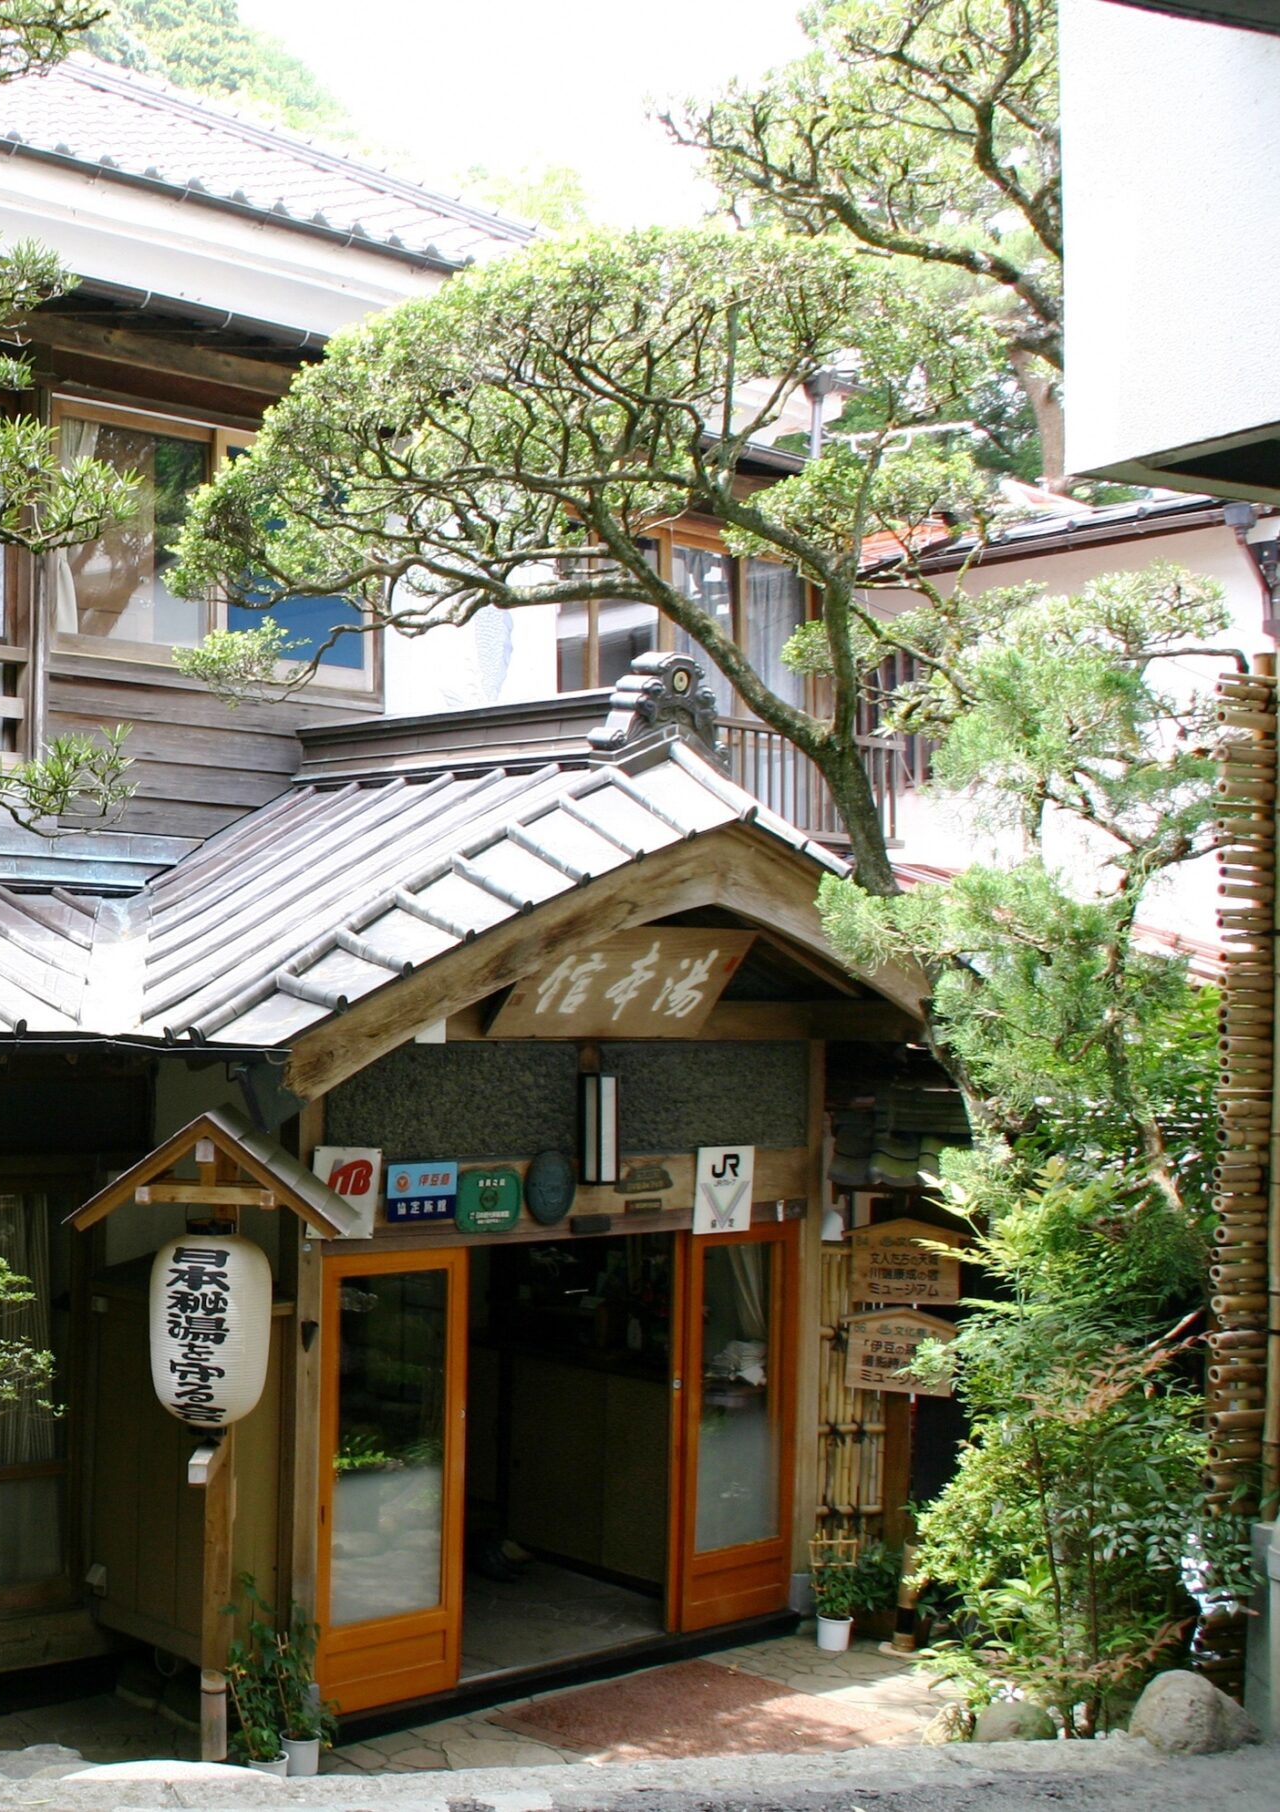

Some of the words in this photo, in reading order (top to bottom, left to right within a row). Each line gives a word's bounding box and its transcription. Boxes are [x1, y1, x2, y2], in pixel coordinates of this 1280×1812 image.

[711, 1153, 740, 1179] JR
[869, 1282, 939, 1297] ミュージアム
[166, 1247, 231, 1422] 日本秘湯を守る会
